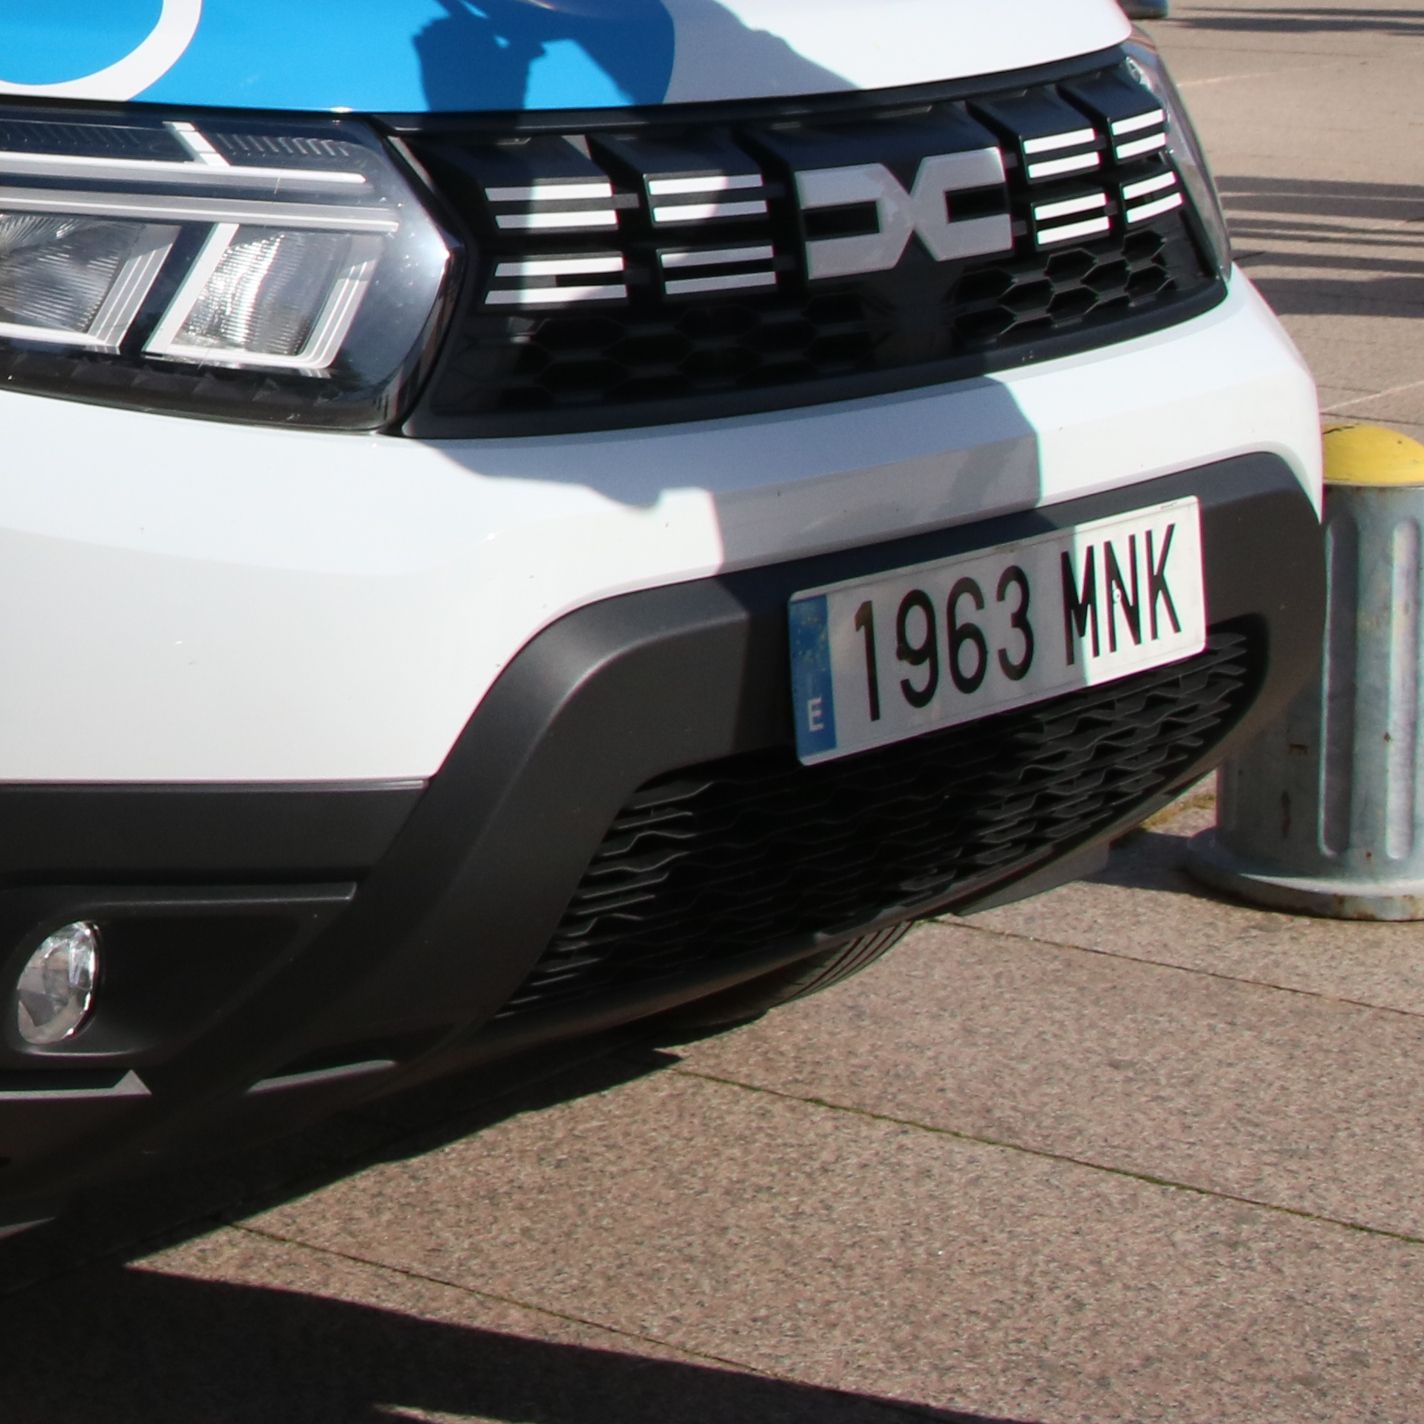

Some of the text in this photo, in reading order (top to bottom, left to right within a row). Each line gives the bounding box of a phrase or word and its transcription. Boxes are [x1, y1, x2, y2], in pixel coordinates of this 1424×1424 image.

[807, 523, 1182, 732] E 1963 MNK
